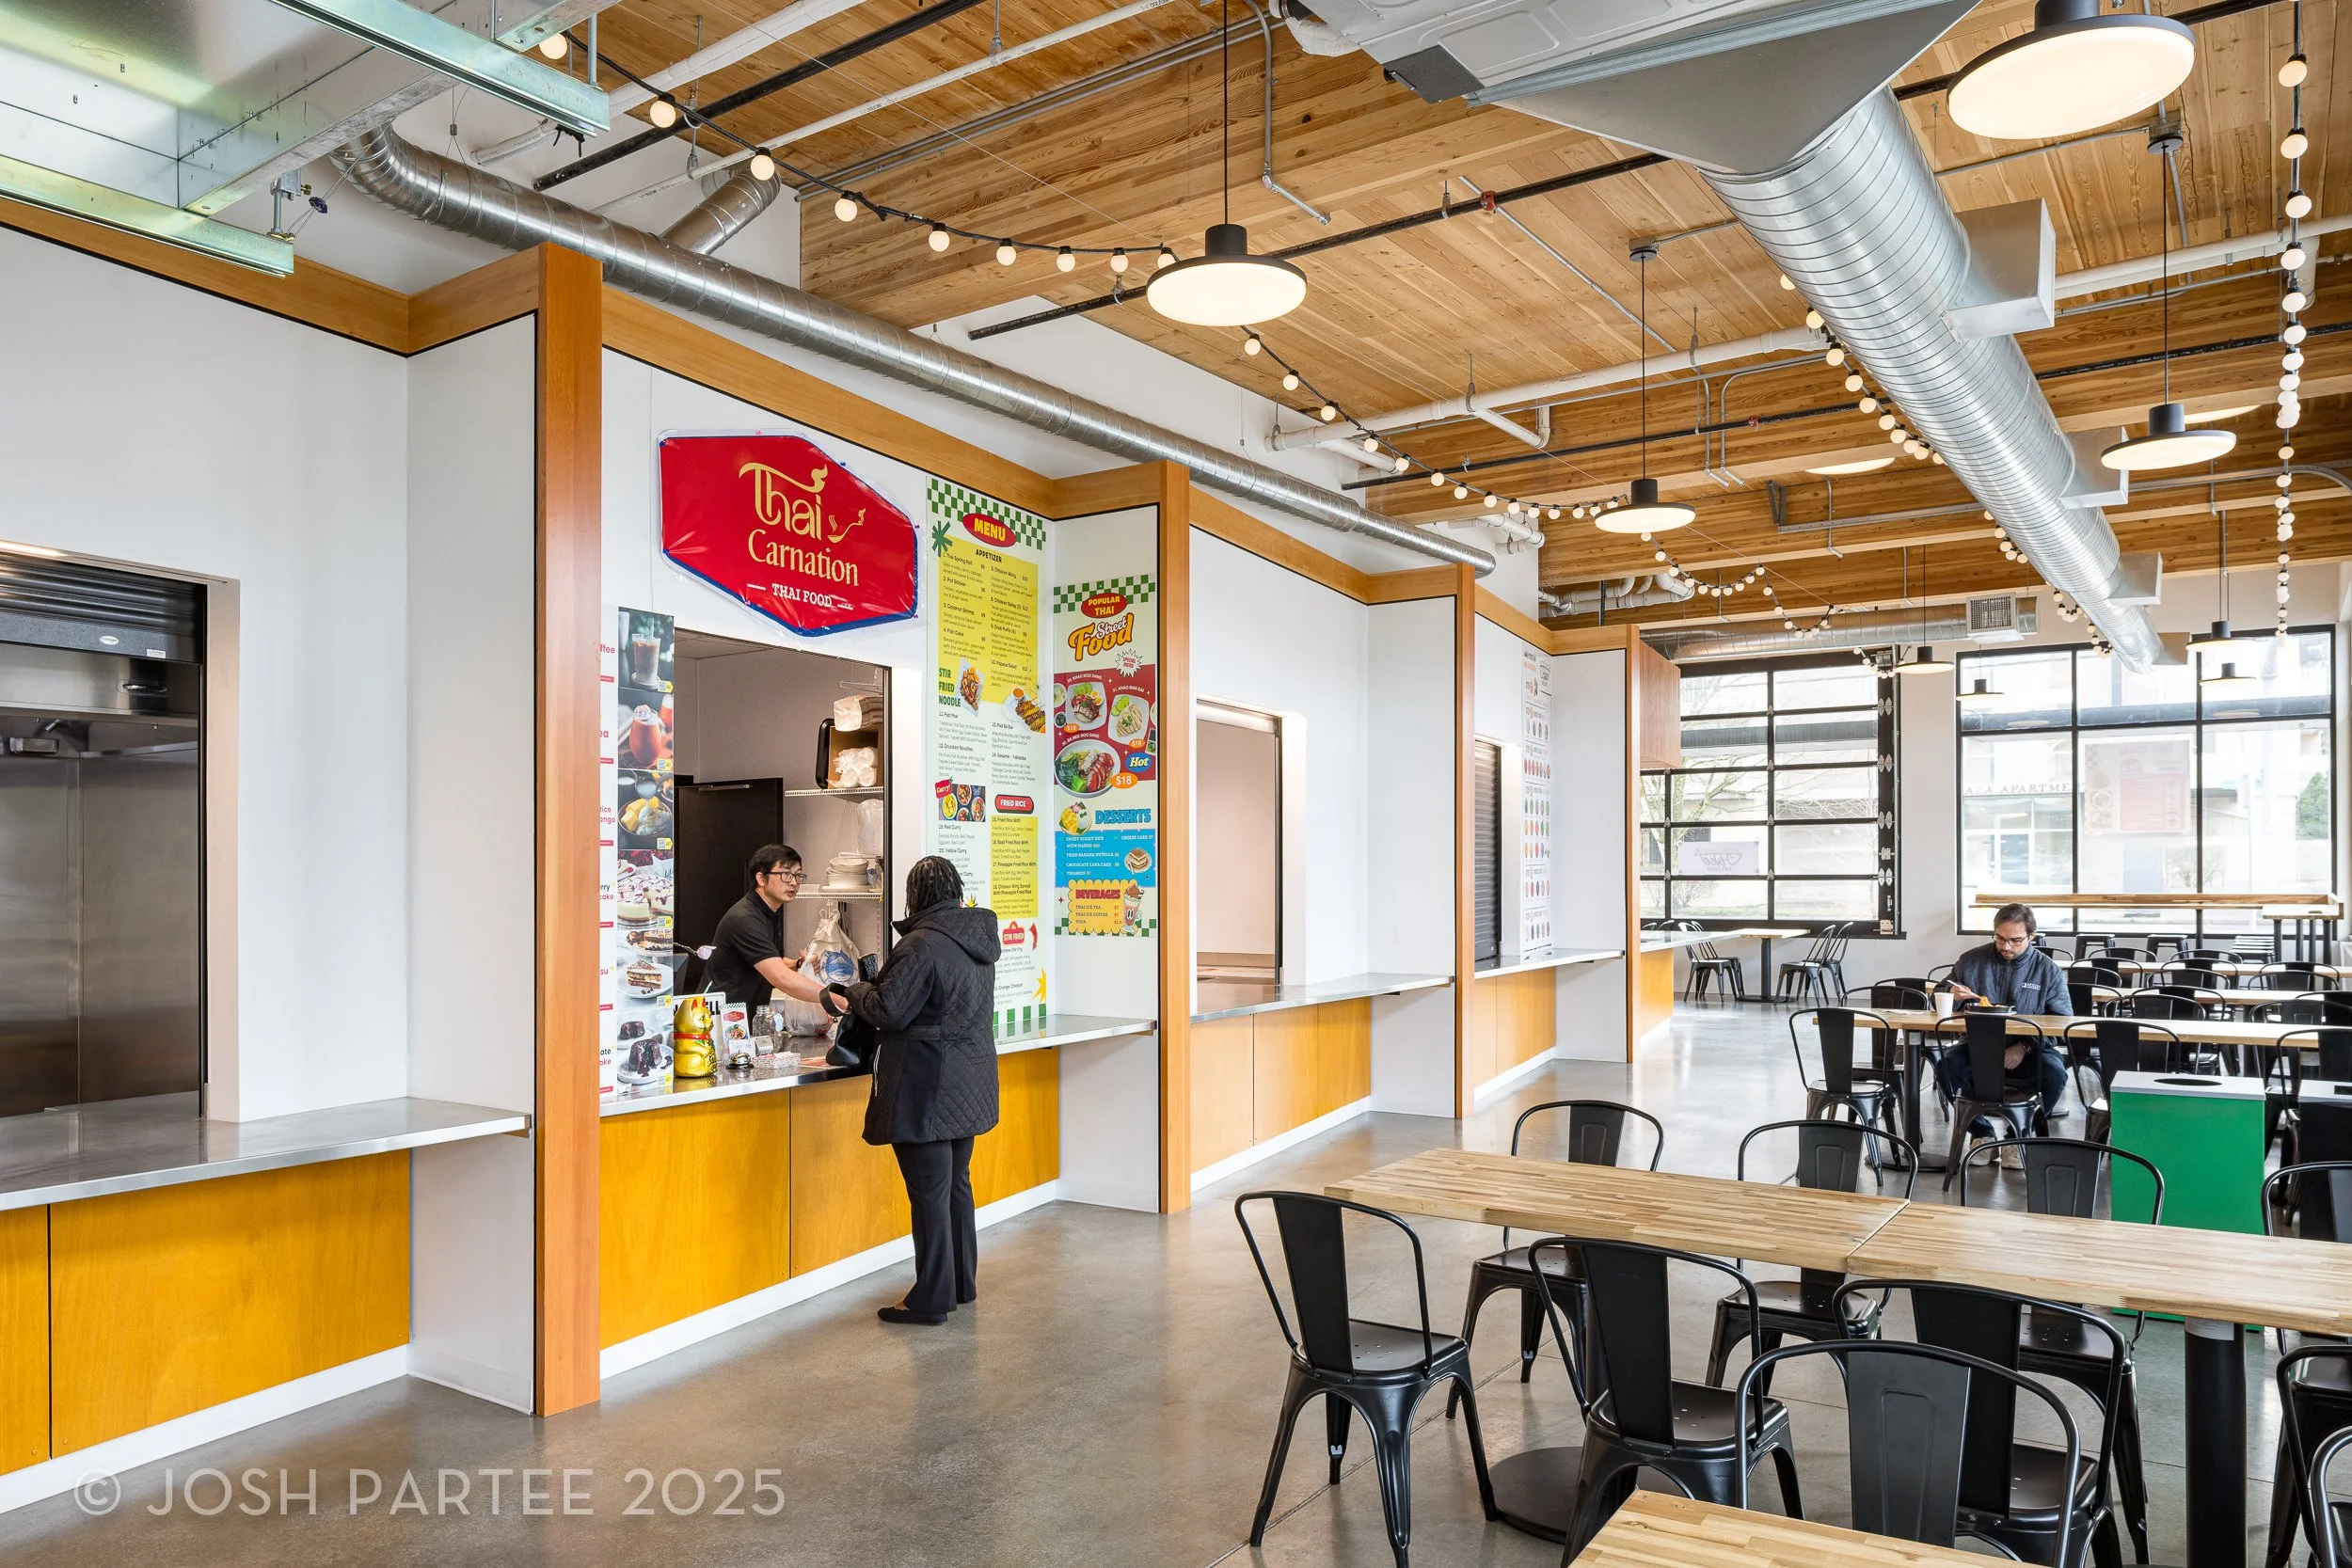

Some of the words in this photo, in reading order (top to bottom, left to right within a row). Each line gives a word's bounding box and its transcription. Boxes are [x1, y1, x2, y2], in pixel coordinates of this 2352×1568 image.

[739, 462, 828, 541] Thai
[974, 518, 1006, 542] MENU
[748, 529, 859, 586] Carnation
[954, 555, 965, 564] Spring
[976, 549, 1002, 562] APPETIZER
[771, 583, 801, 601] THAI
[803, 589, 833, 608] FOOD
[1088, 596, 1120, 606] POPULAR
[1095, 606, 1115, 615] THAI
[1097, 615, 1127, 639] Street
[1068, 612, 1135, 661] Food
[939, 668, 951, 678] STIR
[939, 682, 955, 692] FRIED
[939, 695, 961, 707] NOODLE
[1130, 757, 1149, 767] Hot
[1116, 776, 1132, 785] $18
[1095, 809, 1151, 824] DESSERTS
[1075, 890, 1120, 899] BEVERAGES
